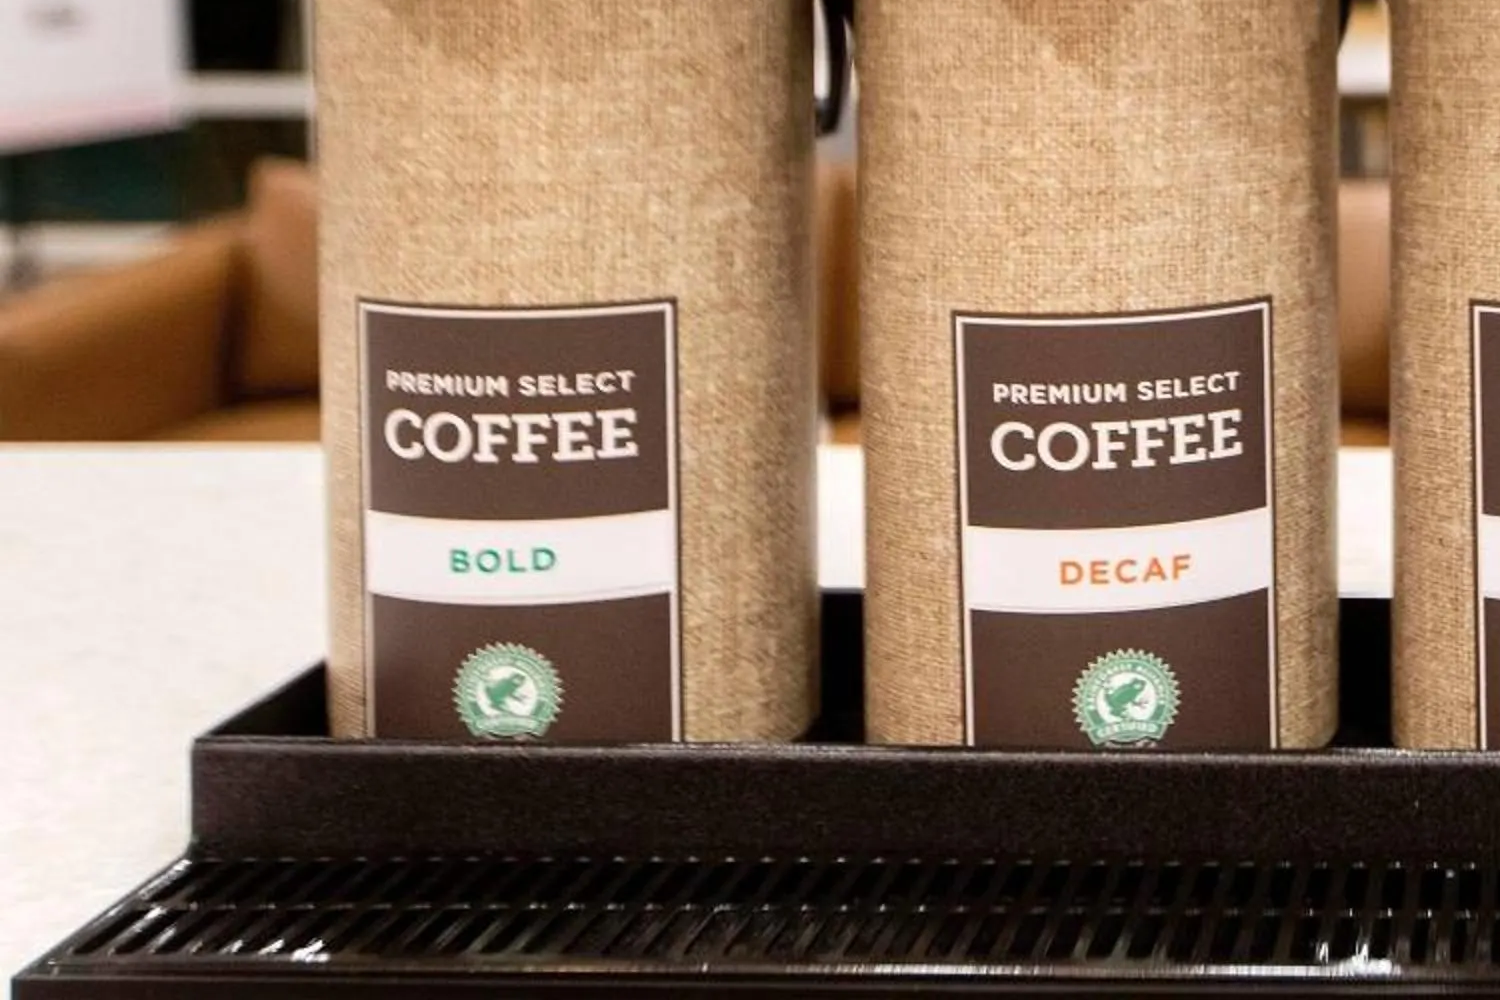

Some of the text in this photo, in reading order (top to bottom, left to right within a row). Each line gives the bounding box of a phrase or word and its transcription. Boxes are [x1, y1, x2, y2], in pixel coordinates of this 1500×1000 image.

[386, 370, 636, 397] PREMIUM SELECT
[992, 371, 1241, 405] PREMIUM SELECT
[384, 408, 638, 463] COFFEE
[990, 409, 1243, 472] COFFEE
[449, 547, 557, 573] BOLD
[1059, 554, 1191, 586] DECAF
